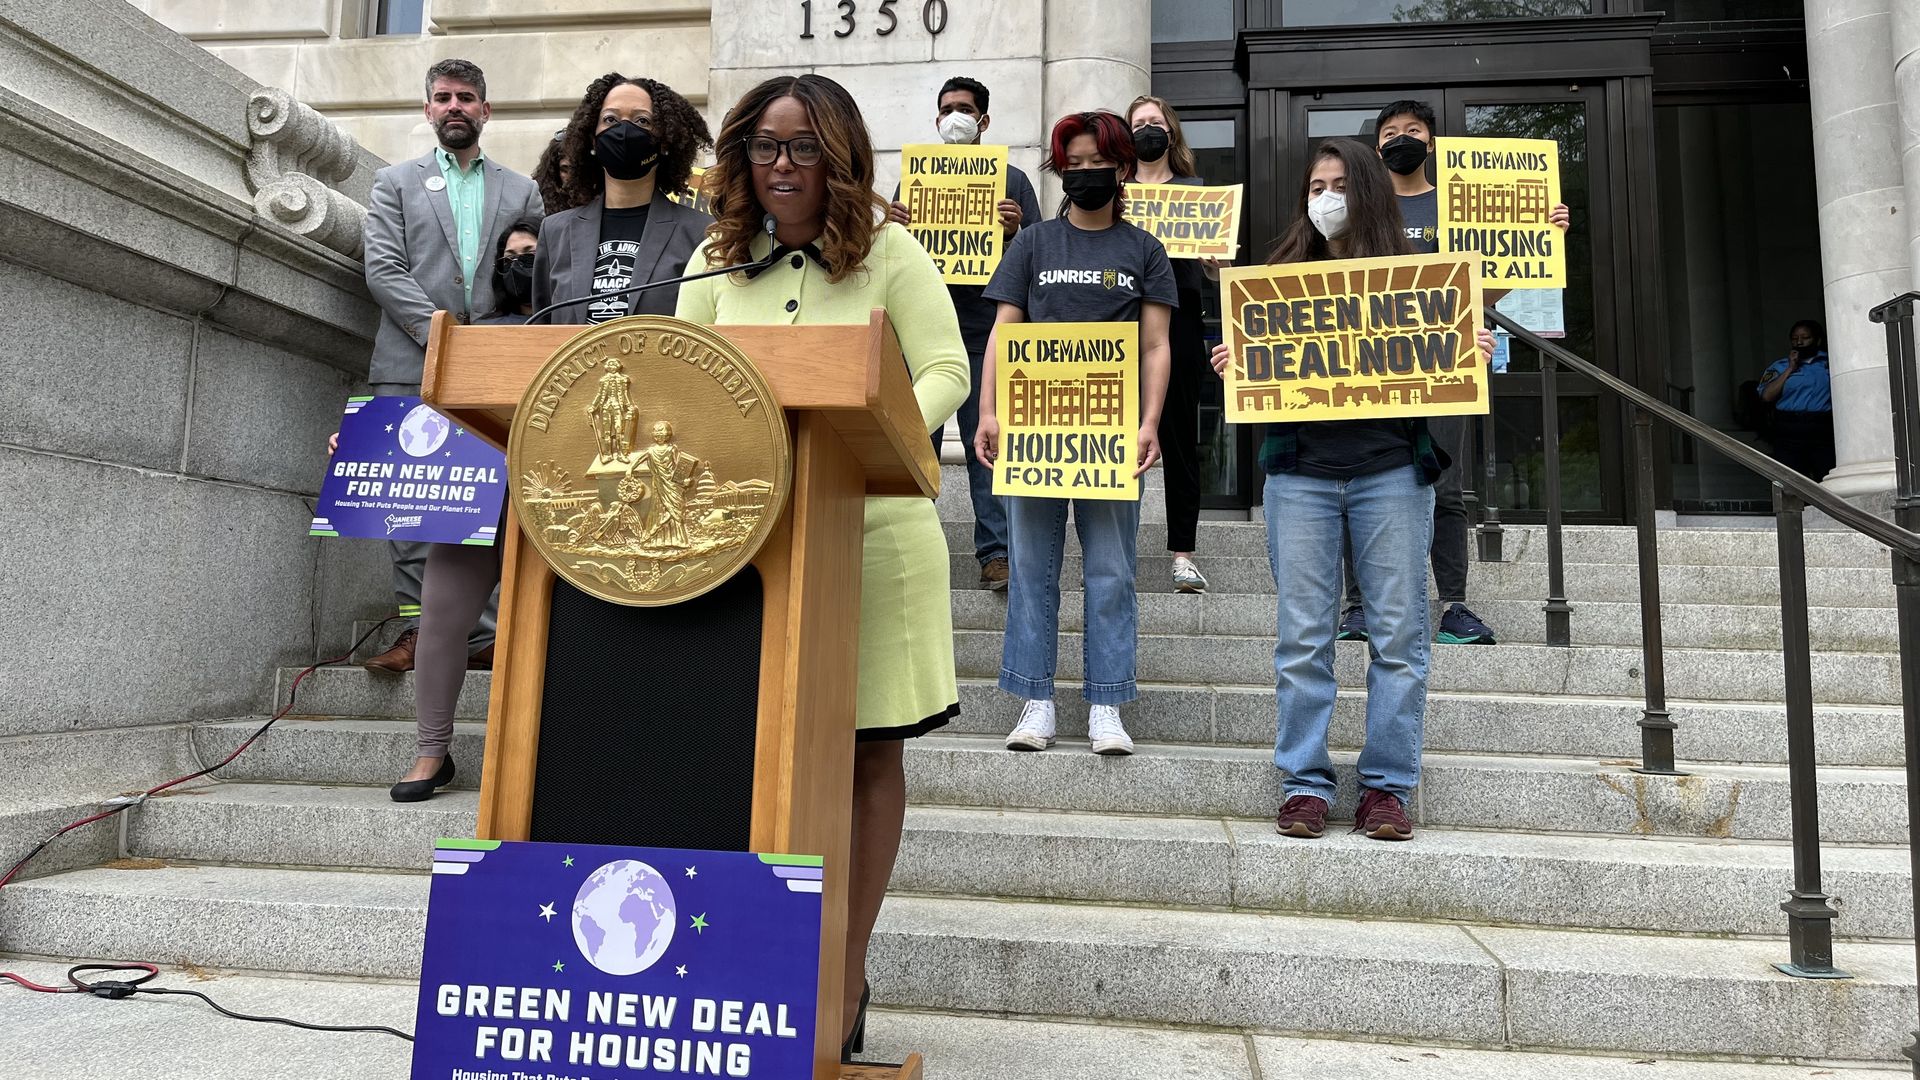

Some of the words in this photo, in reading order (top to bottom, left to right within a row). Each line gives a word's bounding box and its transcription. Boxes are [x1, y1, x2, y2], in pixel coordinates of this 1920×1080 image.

[800, 0, 948, 39] 1350
[909, 156, 927, 175] DC
[930, 157, 998, 176] DEMANDS
[1446, 150, 1467, 169] DC
[1471, 151, 1548, 172] DEMANDS
[1121, 200, 1162, 217] EEN
[1167, 202, 1225, 218] NEW
[1156, 221, 1221, 240] NOW
[598, 243, 613, 255] THE
[617, 243, 640, 254] ADVA
[1448, 227, 1552, 257] HOUSING
[951, 260, 990, 275] ALL
[1504, 261, 1553, 278] ALL
[592, 277, 631, 289] NAACP
[1038, 269, 1102, 286] SUNRISE
[1117, 271, 1134, 290] DC
[1243, 295, 1363, 338] GREEN
[1369, 288, 1458, 332] NEW
[1008, 339, 1031, 363] DC
[1036, 338, 1126, 363] DEMANDS
[1245, 340, 1352, 383] DEAL
[1358, 332, 1459, 377] NOW
[528, 341, 608, 433] DISTRICT
[617, 331, 648, 355] OF
[657, 332, 759, 418] COLUMBIA
[1006, 433, 1125, 464] HOUSING
[334, 461, 394, 479] GREEN
[399, 464, 444, 481] NEW
[449, 466, 499, 484] DEAL
[1005, 466, 1063, 487] FOR
[1072, 468, 1125, 489] ALL
[346, 480, 384, 497] FOR
[388, 482, 476, 502] HOUSING
[335, 500, 360, 508] Housing
[392, 502, 414, 510] People
[415, 503, 428, 511] and
[442, 505, 463, 513] Planet
[464, 506, 480, 514] First
[436, 983, 571, 1023] GREEN
[585, 990, 678, 1030] NEW
[691, 997, 798, 1040] DEAL
[474, 1025, 553, 1064] FOR
[568, 1030, 752, 1079] HOUSING
